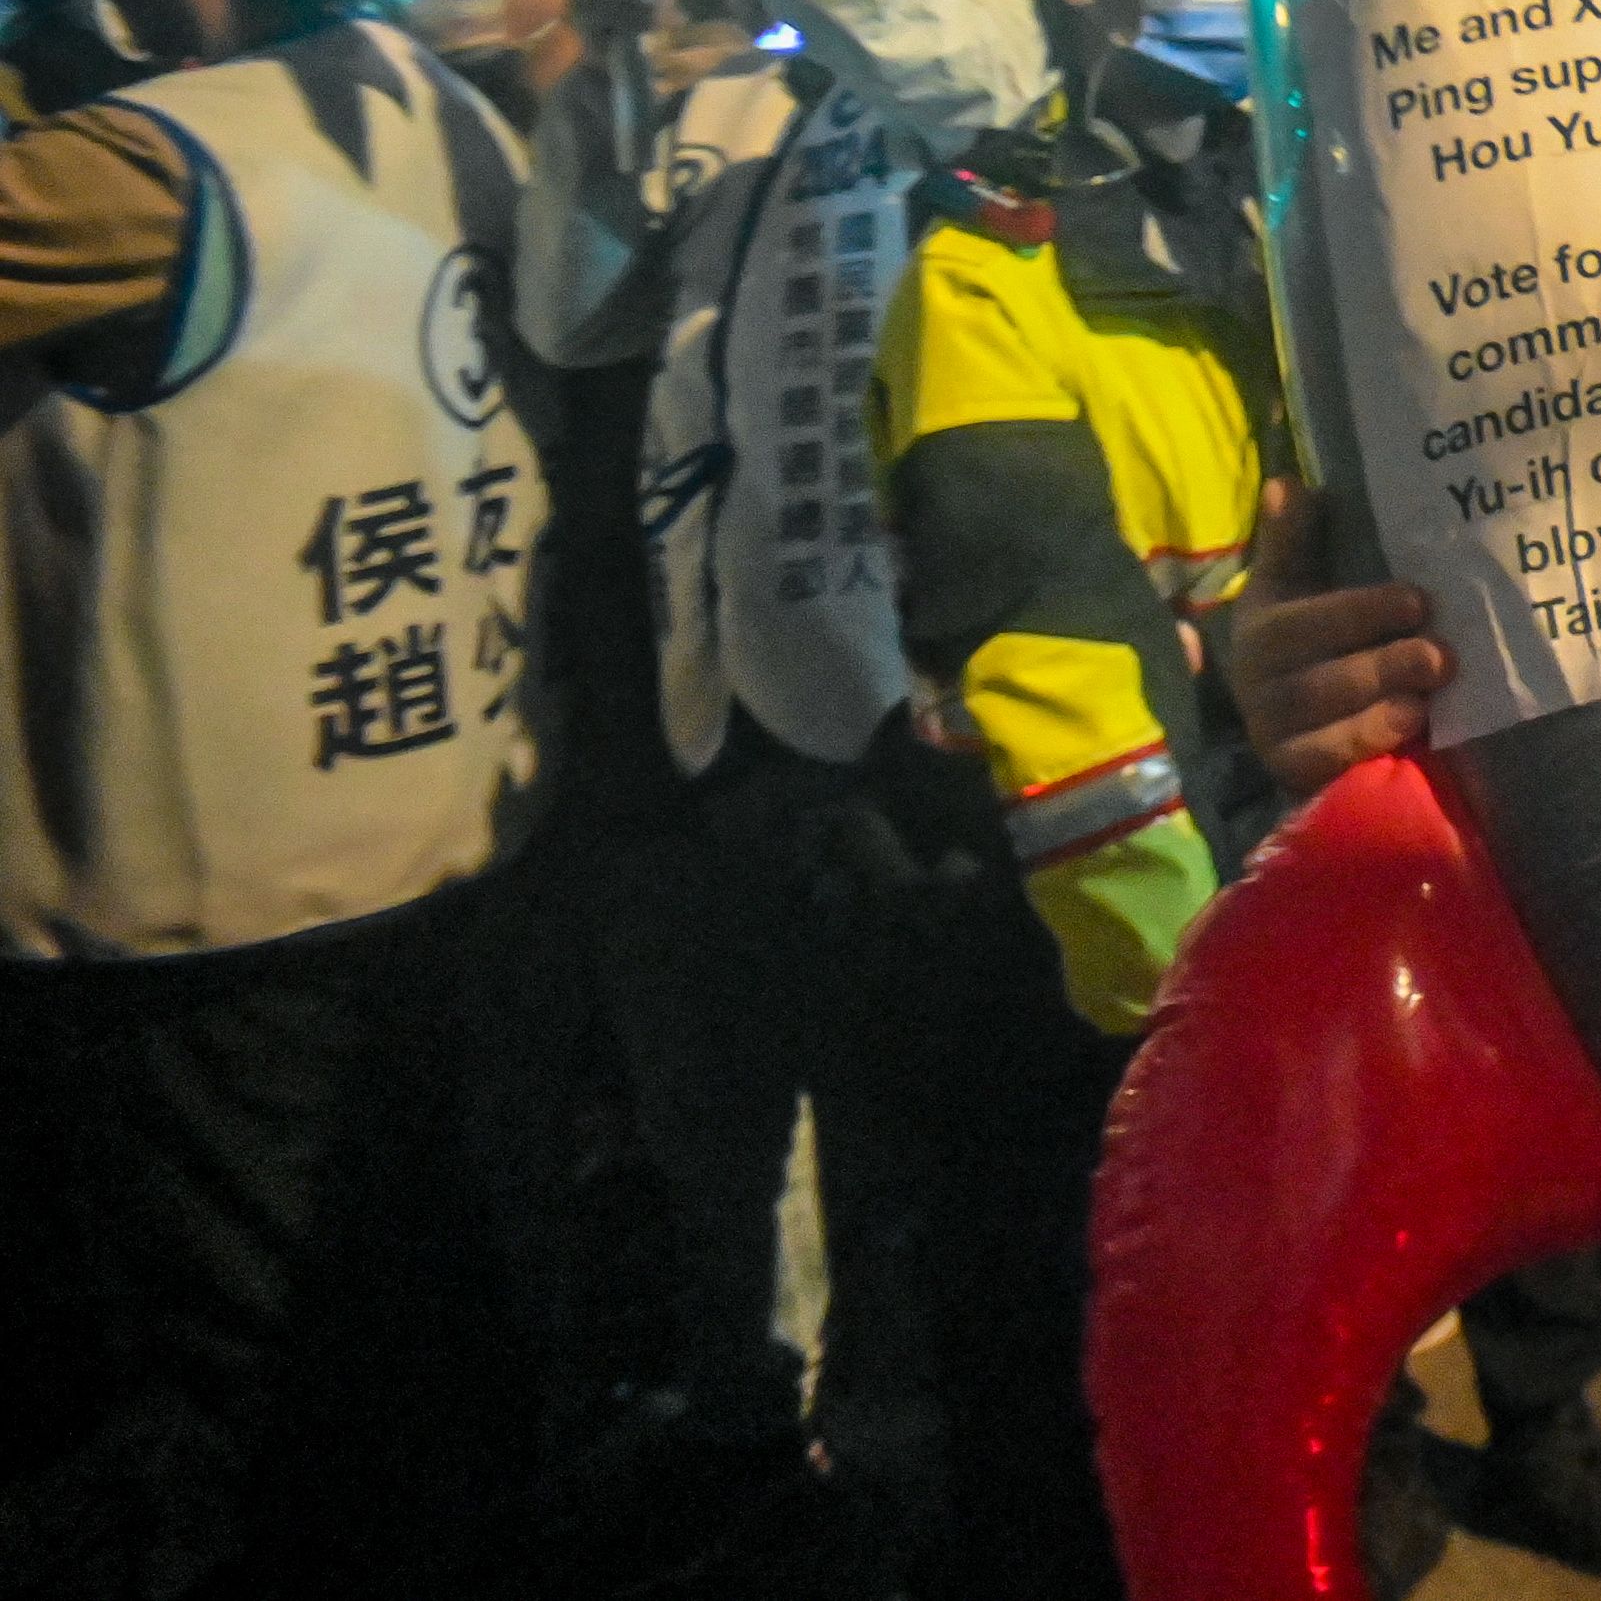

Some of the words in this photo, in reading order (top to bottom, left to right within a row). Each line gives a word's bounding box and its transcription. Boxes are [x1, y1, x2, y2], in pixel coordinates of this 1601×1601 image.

[1369, 23, 1441, 70] Me
[1386, 75, 1494, 130] Ping
[1430, 131, 1532, 182] Hou
[1428, 263, 1538, 317] Vote
[1447, 455, 1571, 521] Yu-ih
